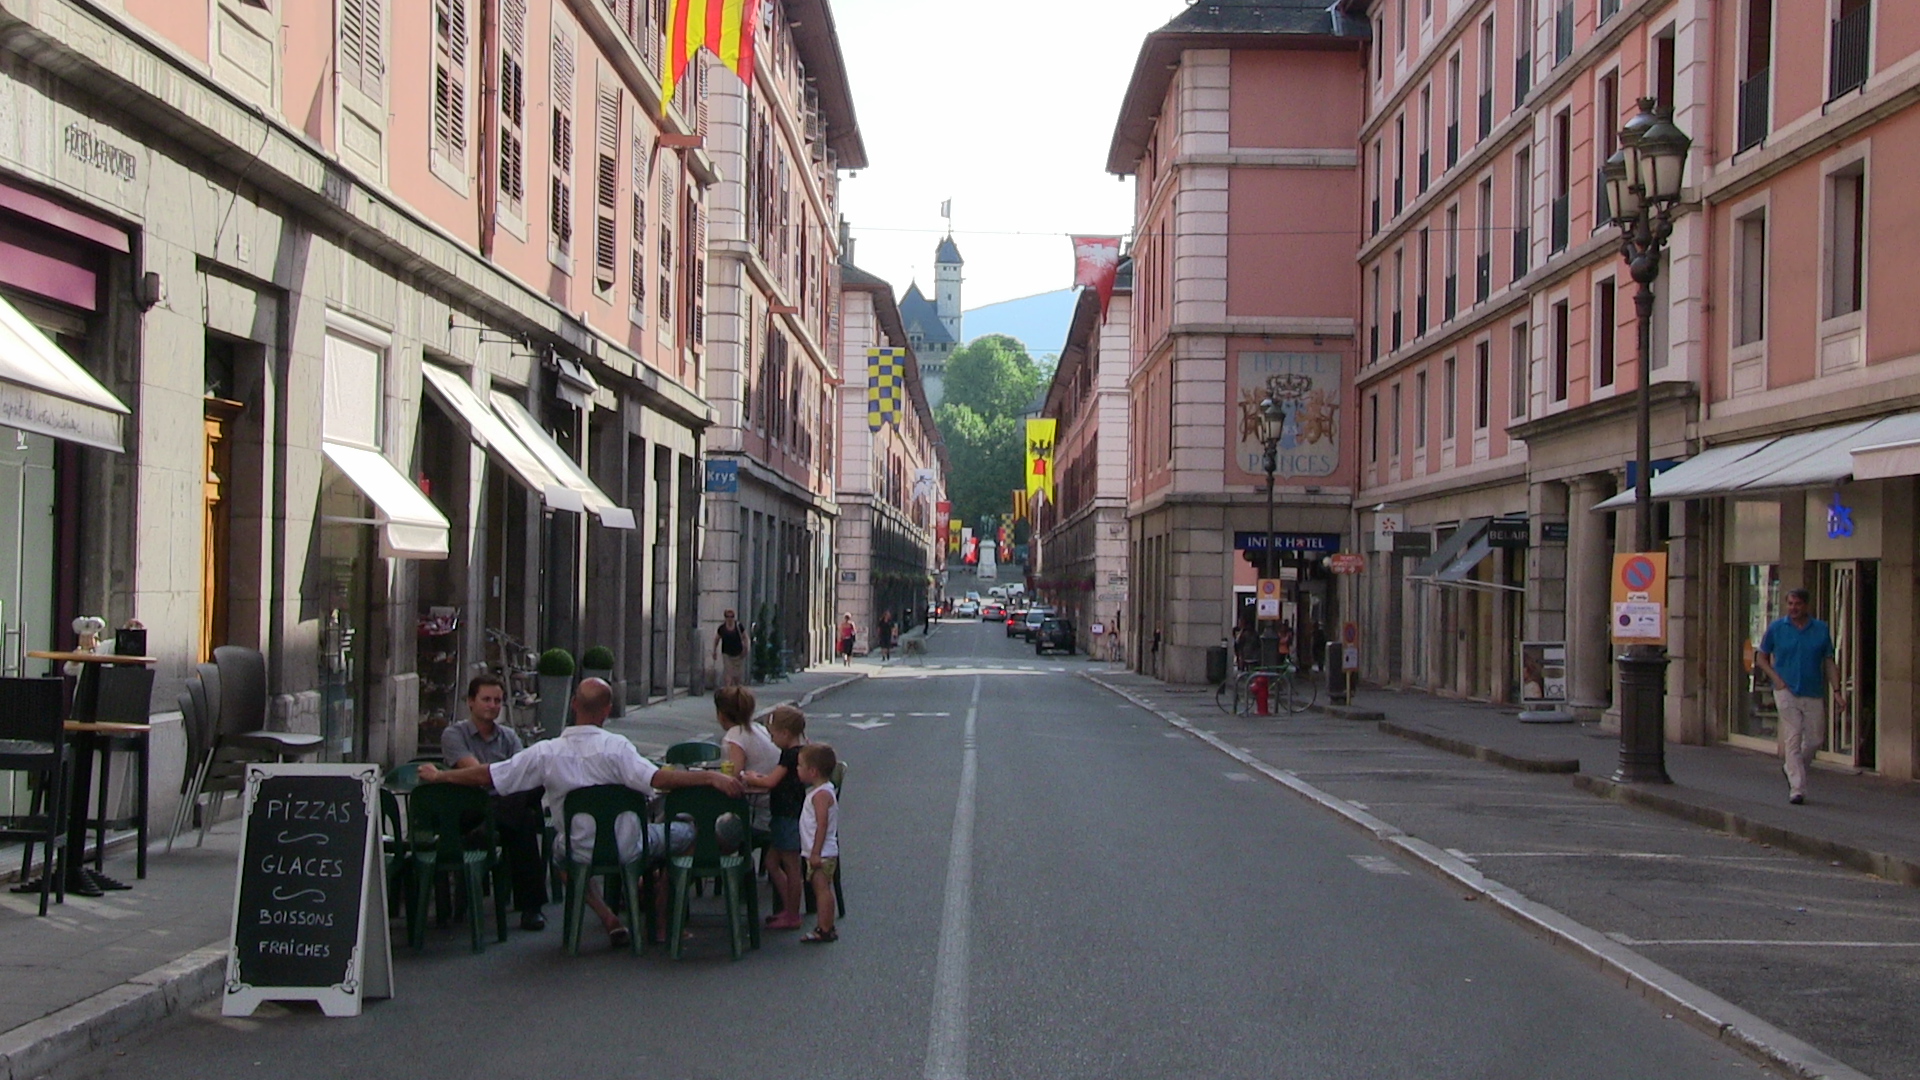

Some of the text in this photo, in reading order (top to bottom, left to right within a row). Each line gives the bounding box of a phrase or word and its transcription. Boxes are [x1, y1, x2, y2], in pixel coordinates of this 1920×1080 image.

[1248, 453, 1331, 473] PNCES
[707, 470, 736, 485] Krys
[1247, 536, 1283, 548] INTR
[261, 854, 343, 878] GLACES
[259, 909, 334, 927] BOISSONS
